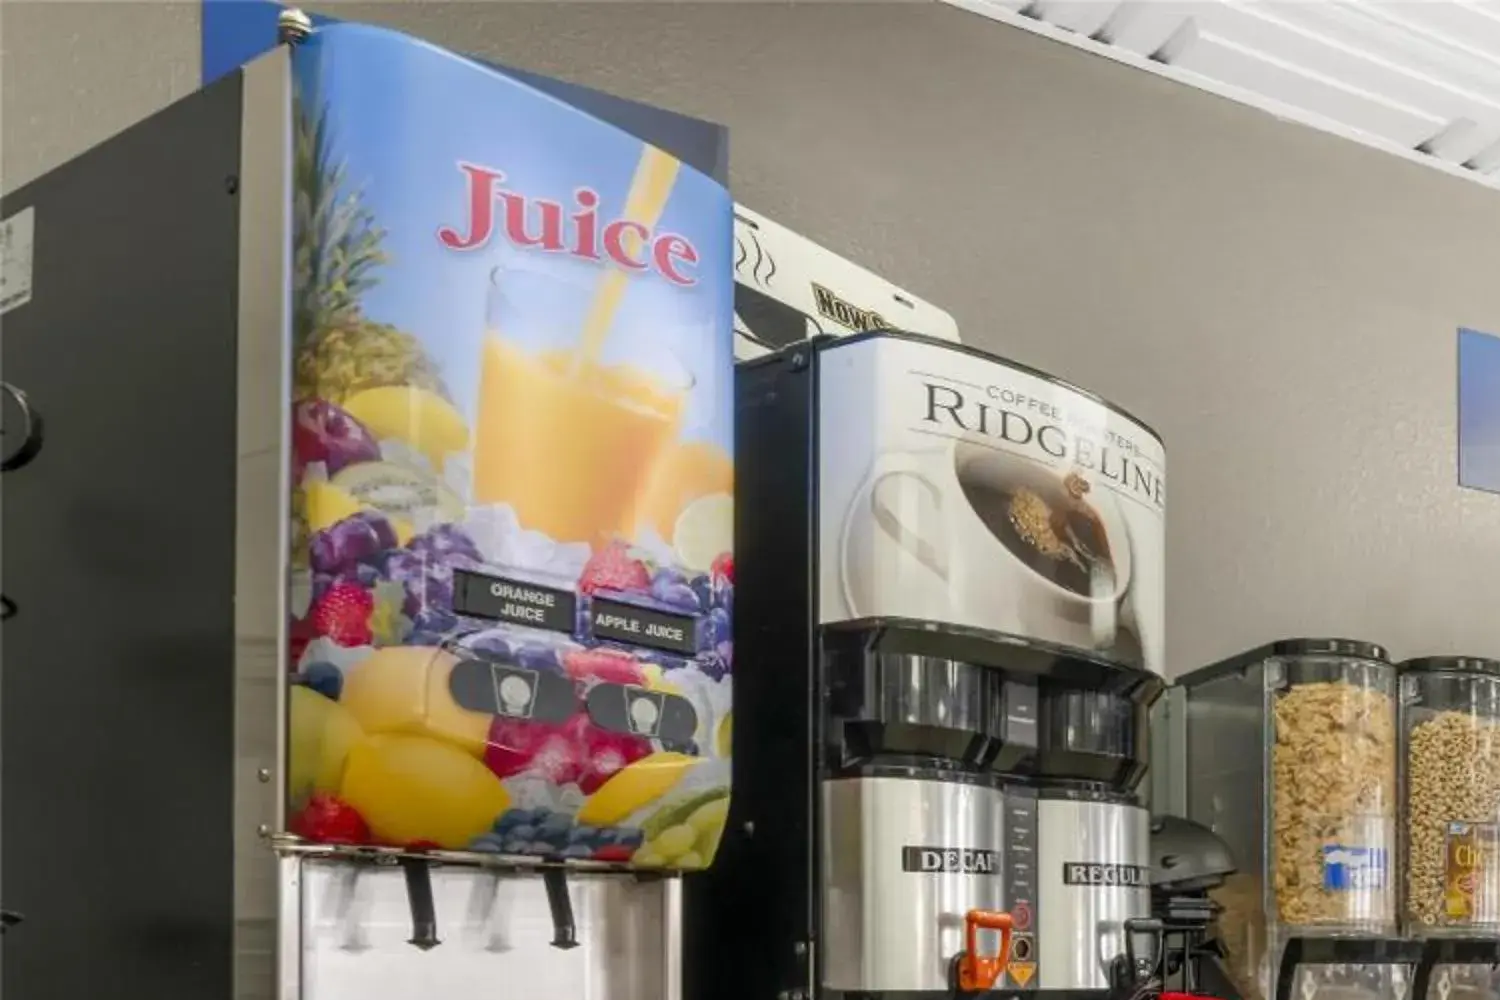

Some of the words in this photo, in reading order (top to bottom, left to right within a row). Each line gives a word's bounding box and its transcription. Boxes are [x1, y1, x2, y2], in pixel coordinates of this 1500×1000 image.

[437, 161, 699, 286] Juice
[985, 384, 1062, 421] COFFEE
[922, 382, 1165, 506] RIDGELINE
[490, 582, 555, 608] ORANGE
[500, 603, 545, 622] JUICE
[595, 613, 641, 634] APPLE
[645, 622, 683, 642] JUICE
[921, 851, 999, 872] DECAF
[1071, 865, 1149, 886] REGUL
